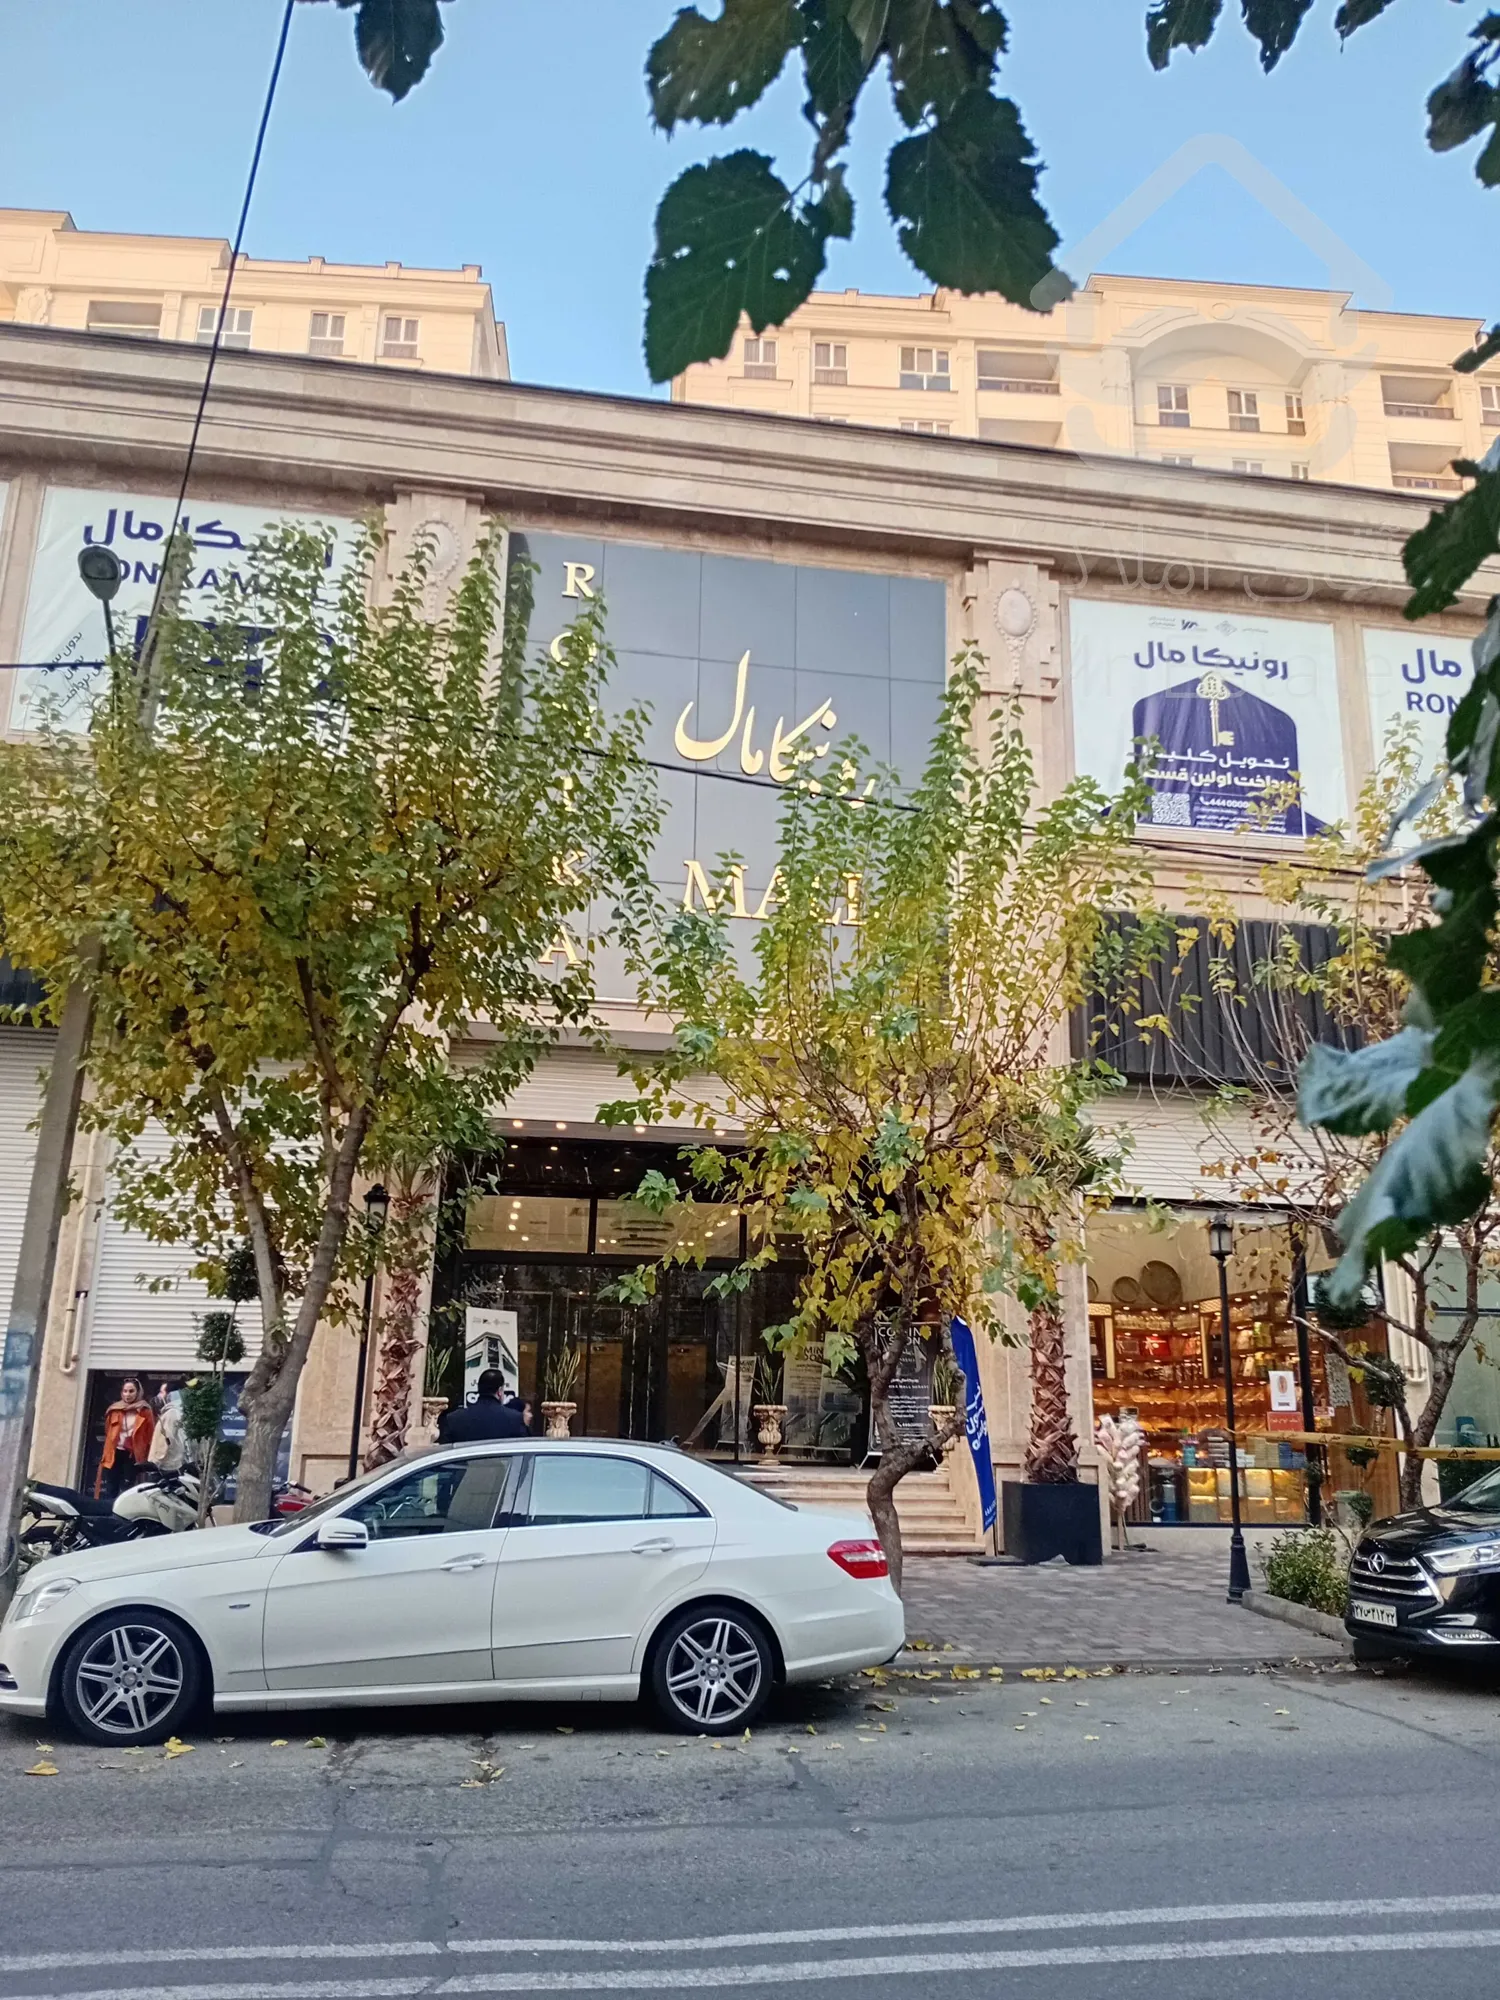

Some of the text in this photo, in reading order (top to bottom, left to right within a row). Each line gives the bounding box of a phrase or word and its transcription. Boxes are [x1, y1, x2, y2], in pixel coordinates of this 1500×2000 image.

[83, 508, 164, 546] مال
[1133, 640, 1289, 681] رونیکا مال
[1401, 647, 1463, 685] مال
[1190, 769, 1232, 788] اولین
